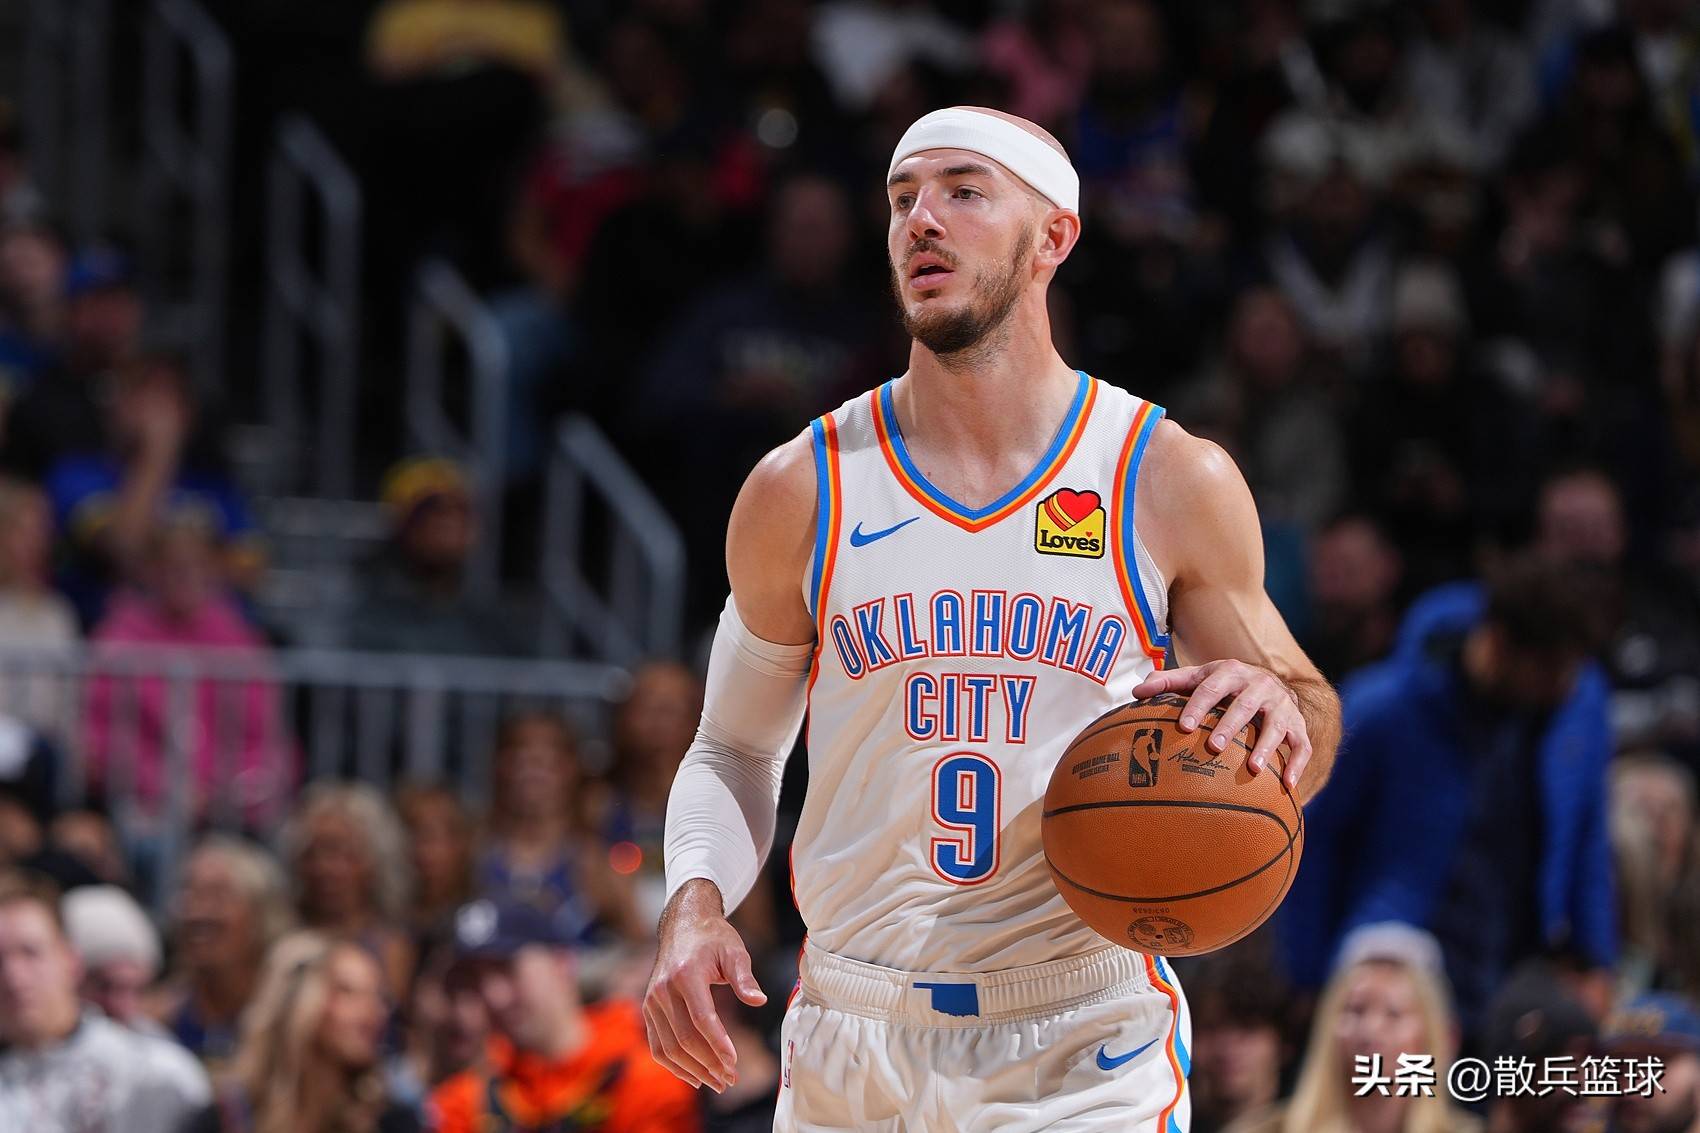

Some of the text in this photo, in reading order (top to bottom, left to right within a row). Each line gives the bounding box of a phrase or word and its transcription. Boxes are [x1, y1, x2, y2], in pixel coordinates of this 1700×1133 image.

[1040, 528, 1100, 553] Love's
[830, 589, 1126, 686] OKLAHOMA
[904, 671, 1037, 745] CITY
[930, 751, 1003, 886] 9
